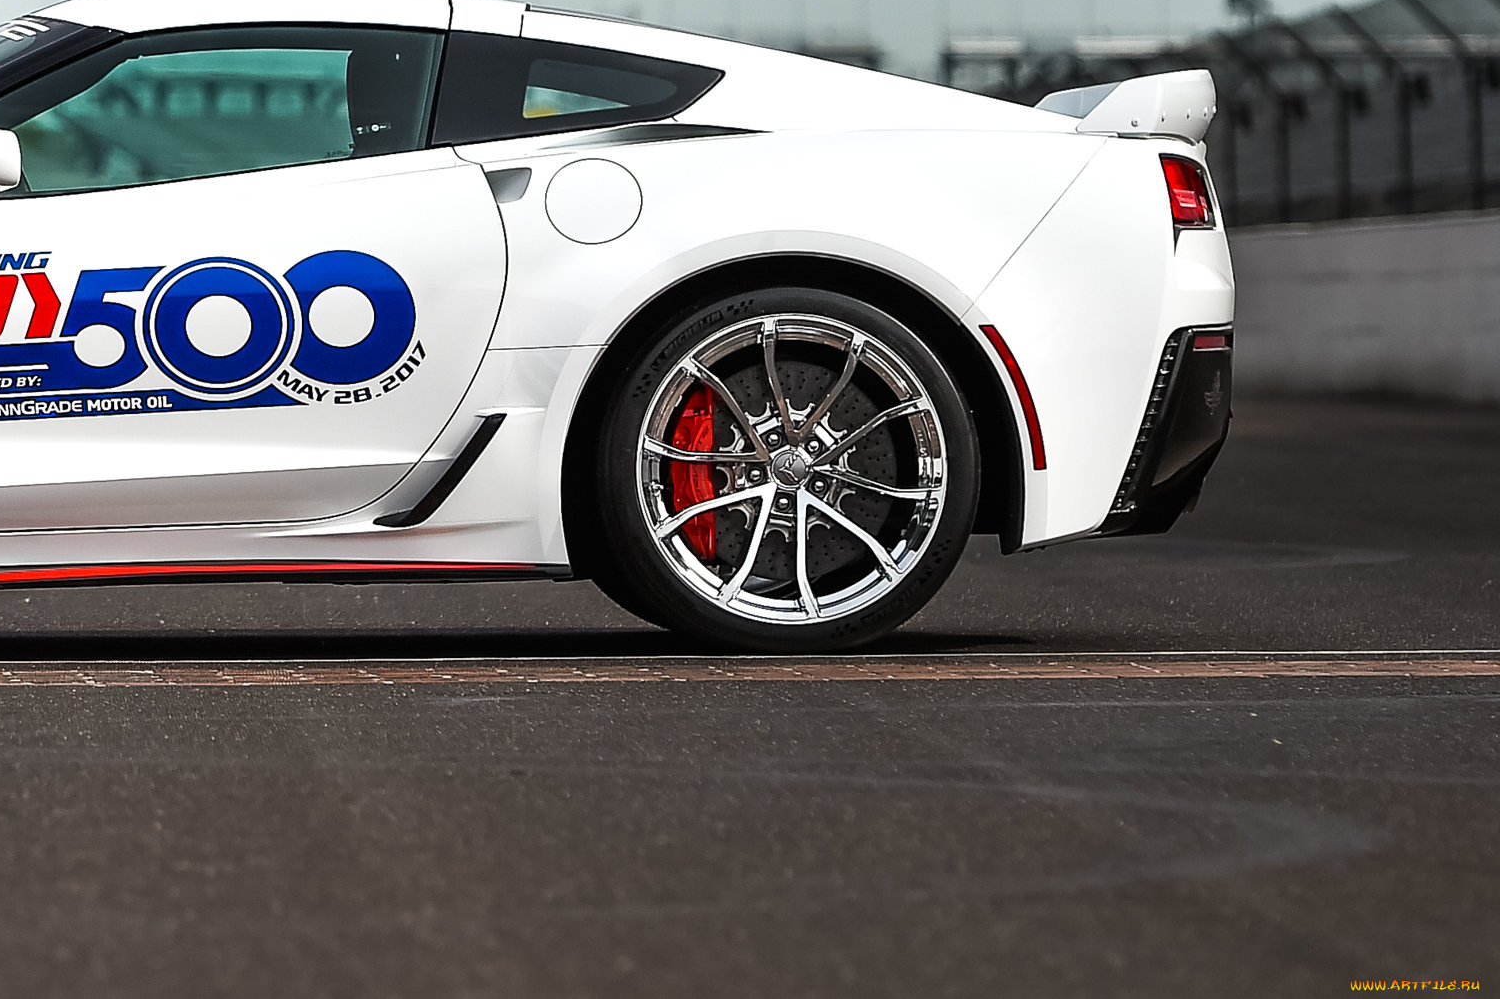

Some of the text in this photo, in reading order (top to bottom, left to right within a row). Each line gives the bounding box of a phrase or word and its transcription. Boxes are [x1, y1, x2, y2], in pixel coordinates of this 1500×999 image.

[59, 250, 416, 396] 500
[16, 375, 42, 387] BY:
[276, 369, 330, 402] MAY
[87, 397, 143, 412] MOTOR
[147, 395, 173, 409] OIL
